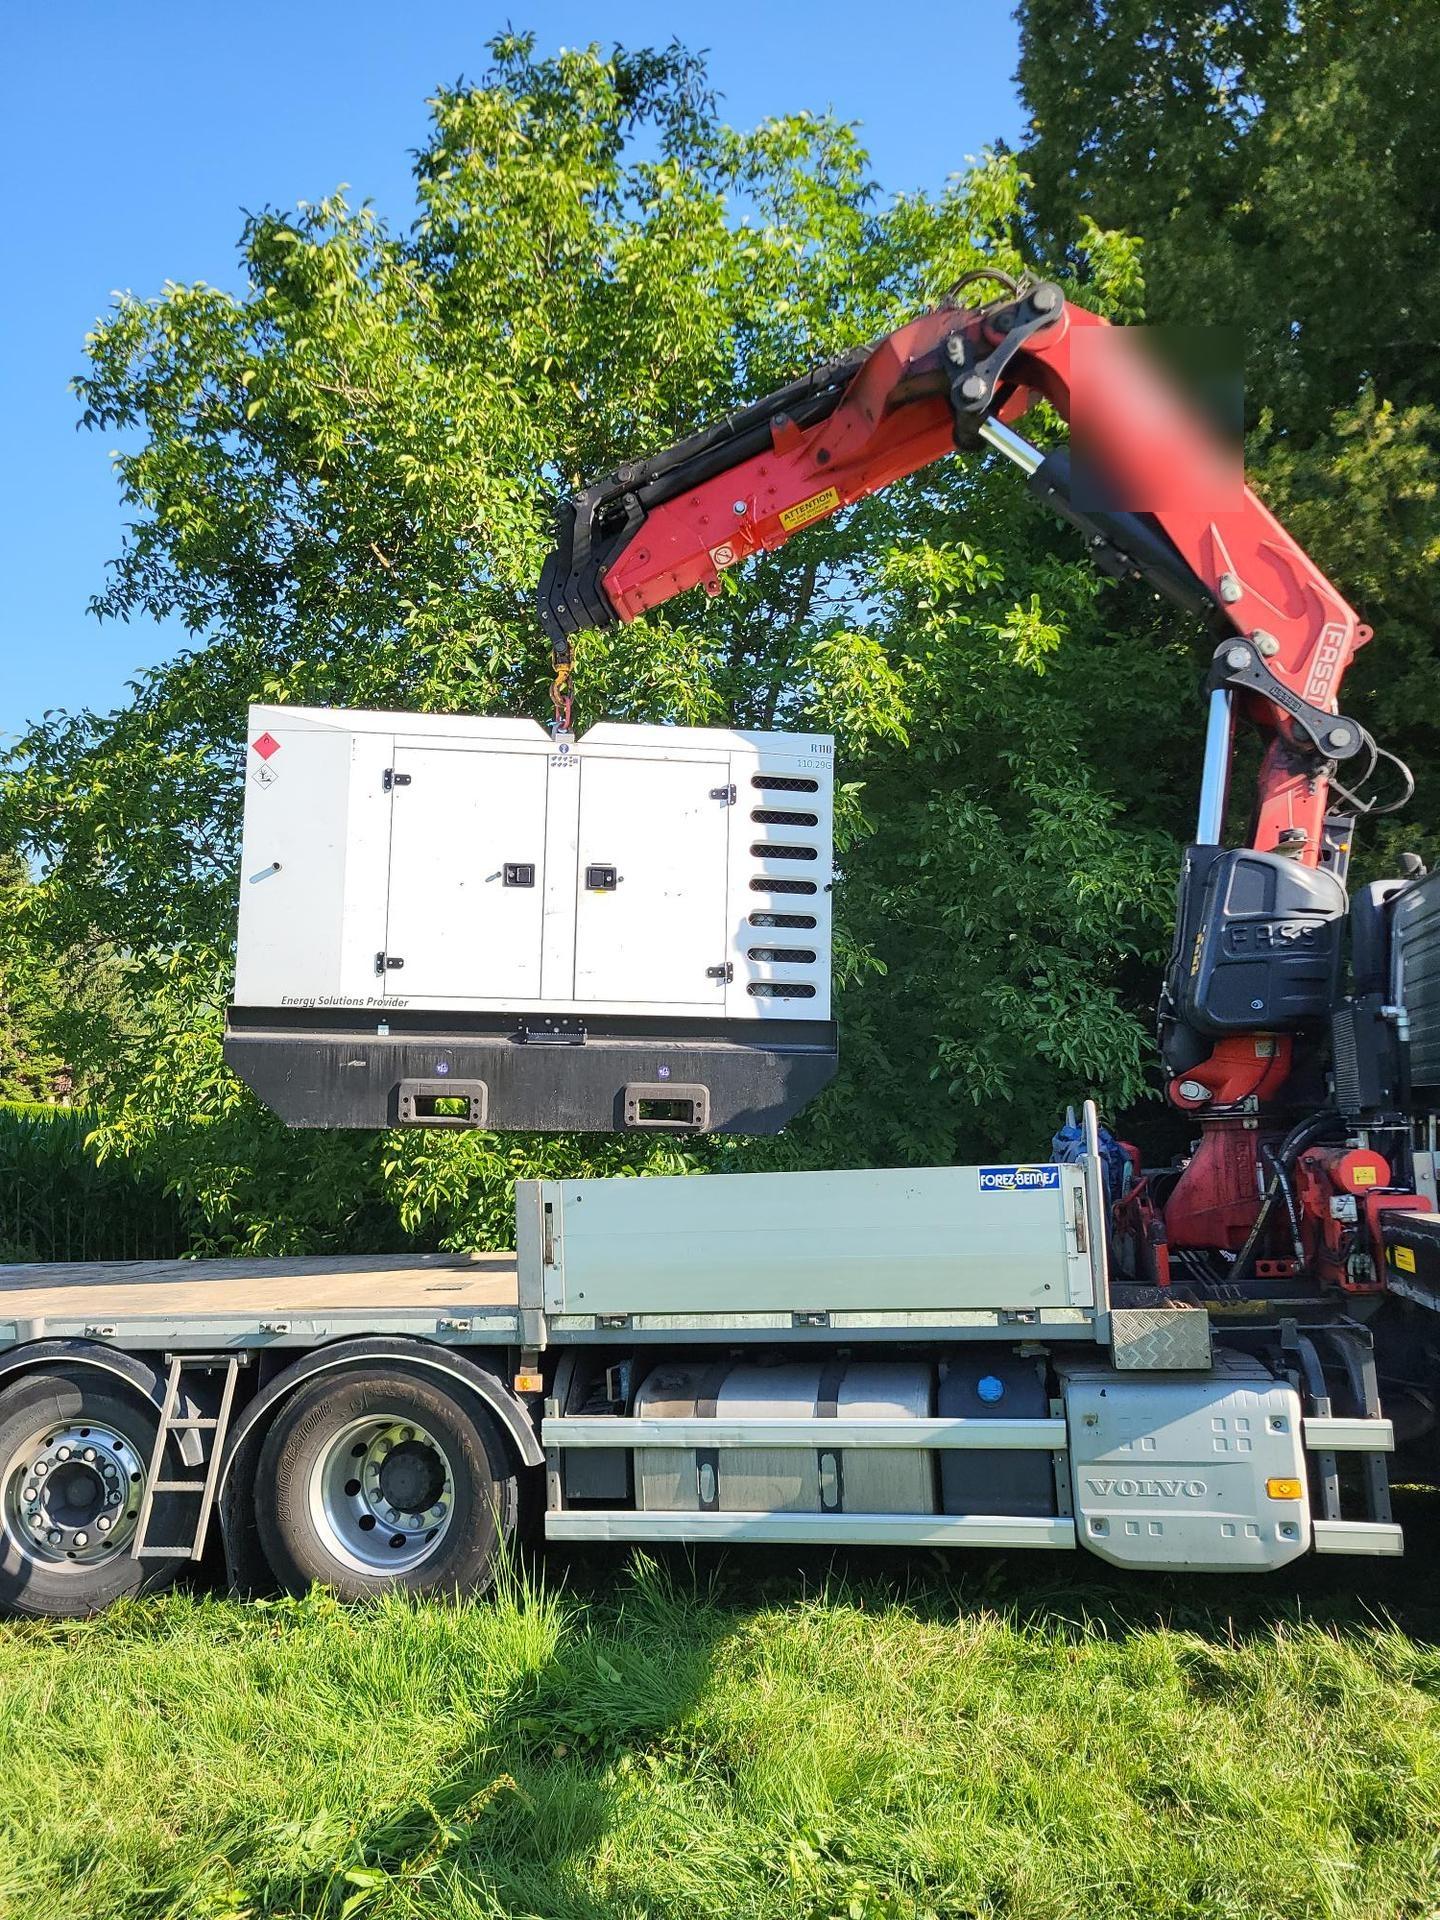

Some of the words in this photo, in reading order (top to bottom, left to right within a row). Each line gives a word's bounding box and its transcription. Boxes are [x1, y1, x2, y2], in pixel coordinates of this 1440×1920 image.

[784, 490, 833, 521] ATTENTION
[1308, 629, 1344, 709] FASSI
[281, 995, 316, 1008] Energy
[318, 995, 364, 1006] Solutions
[366, 996, 409, 1008] Provider
[980, 1172, 1057, 1187] FOREZ-BENNES
[1086, 1478, 1208, 1498] VOLVO
